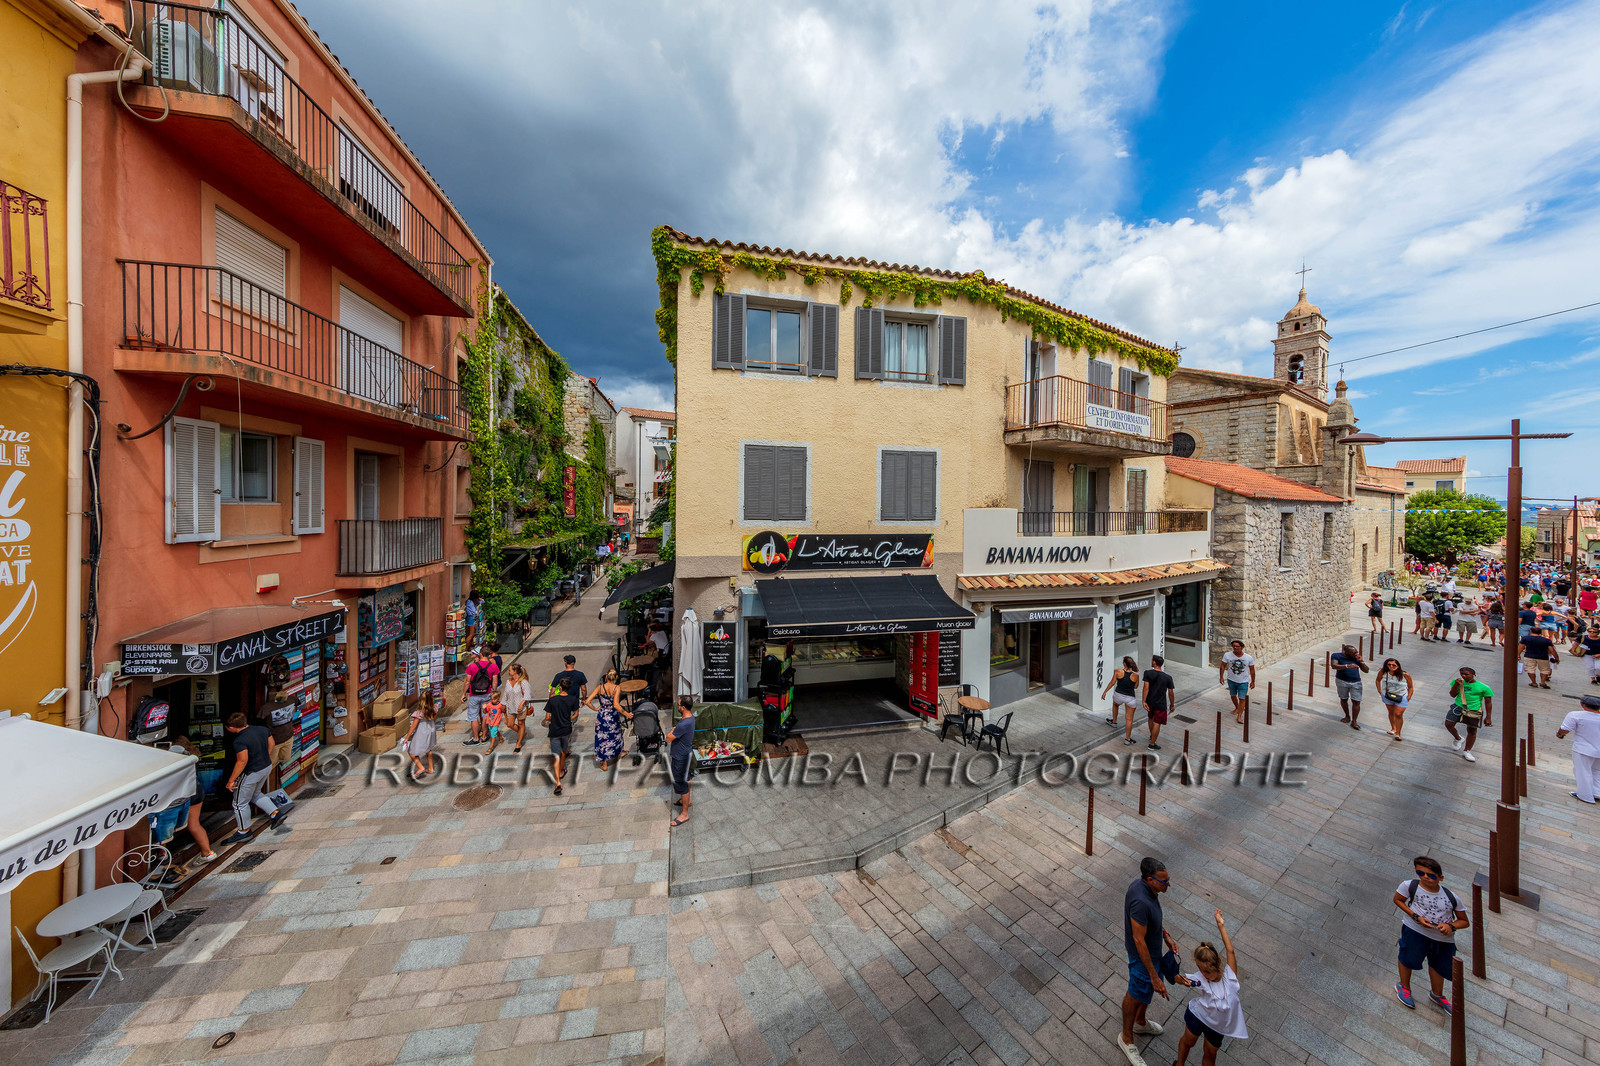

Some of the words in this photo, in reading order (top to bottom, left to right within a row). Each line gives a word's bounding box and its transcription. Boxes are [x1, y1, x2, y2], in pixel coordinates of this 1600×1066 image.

[1088, 406, 1110, 419] CENTRE
[1110, 410, 1149, 426] D'INFORMATION
[1096, 417, 1103, 427] ET
[1104, 419, 1142, 433] D'ORIENTATION
[798, 537, 859, 558] L'Art
[874, 539, 924, 567] Glace
[986, 546, 1043, 564] BANANA
[1045, 546, 1091, 563] MOON
[1029, 611, 1053, 620] BANANA
[1054, 610, 1073, 619] MOON
[220, 635, 271, 666] CANAL
[275, 617, 331, 648] STREET
[333, 613, 342, 631] 2
[1096, 616, 1104, 658] BANANA
[1096, 660, 1104, 690] MOON
[35, 839, 67, 865] de
[73, 823, 98, 846] la
[104, 794, 159, 829] Corse
